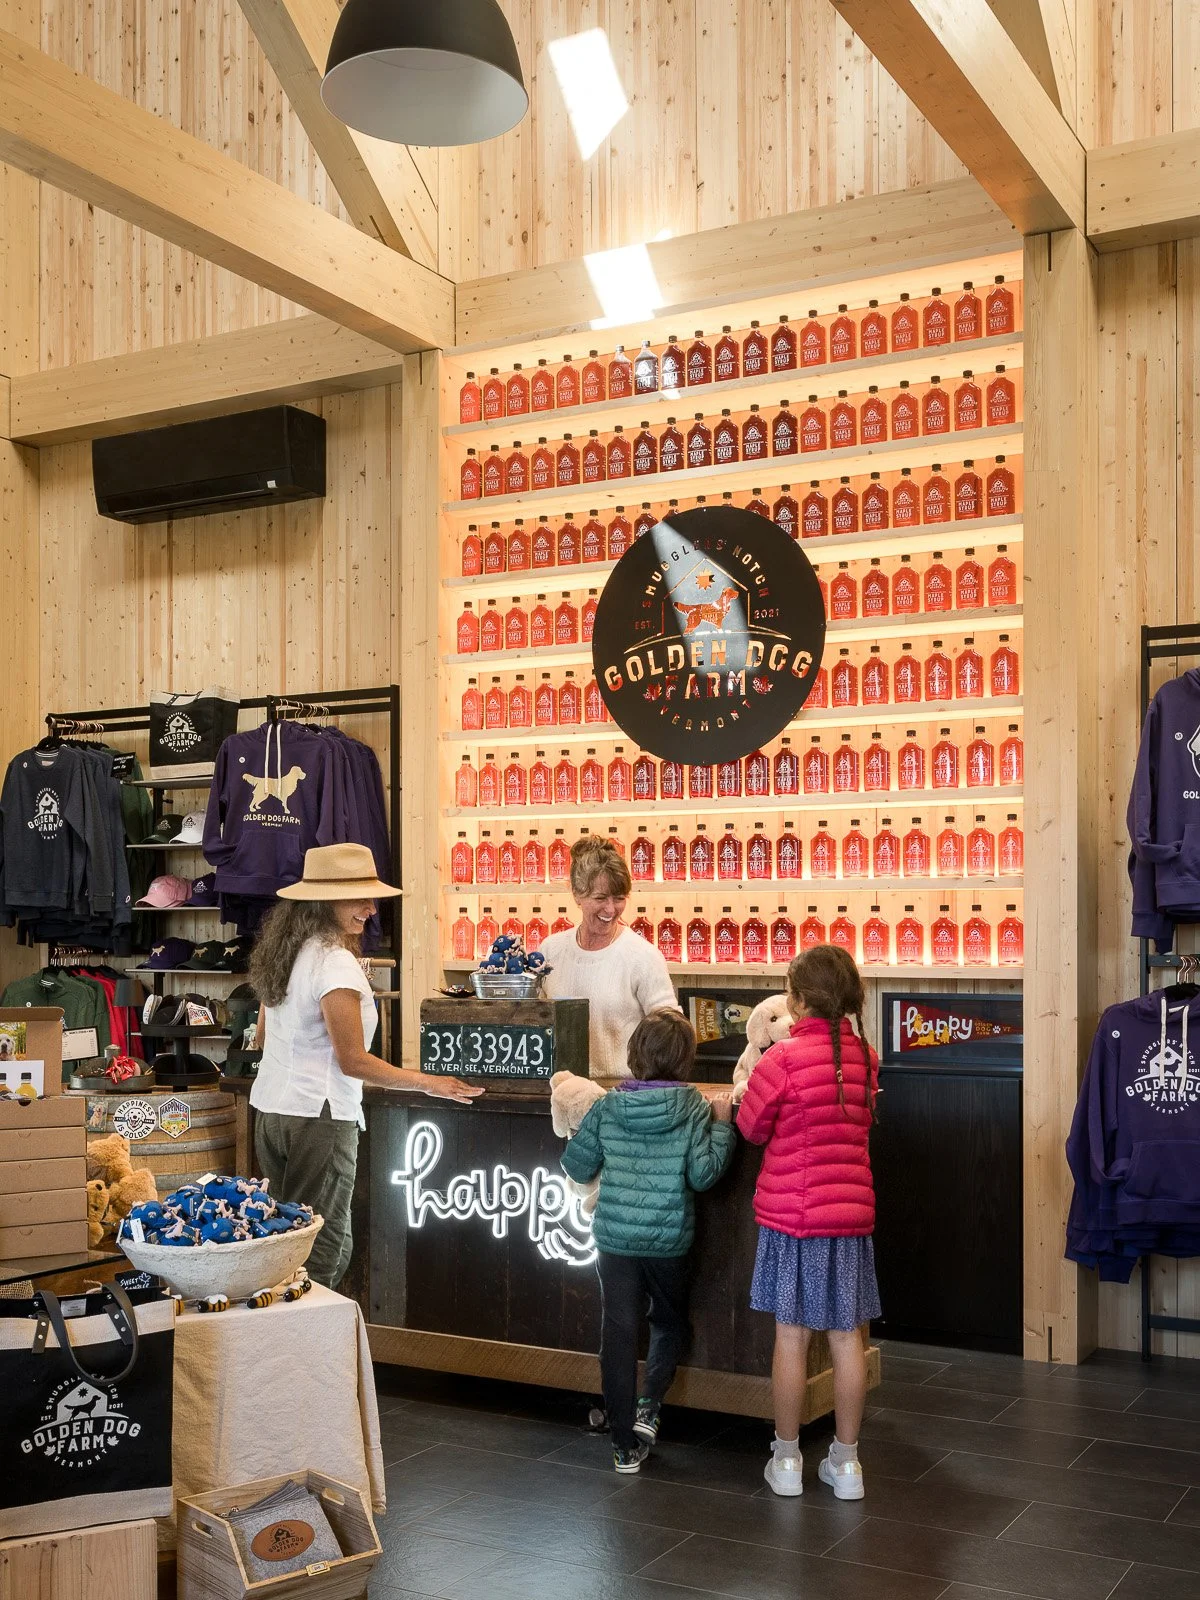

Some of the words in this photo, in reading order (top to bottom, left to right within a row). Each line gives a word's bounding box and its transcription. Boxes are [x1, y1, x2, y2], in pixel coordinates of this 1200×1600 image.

[732, 545, 770, 598] NOTCH
[635, 621, 655, 630] EST.
[604, 640, 726, 692] GOLDEN
[745, 640, 813, 678] DOG
[666, 669, 746, 700] FARM
[660, 700, 751, 731] VERMONT
[160, 733, 185, 744] GOLDEN
[706, 1009, 714, 1032] FARM
[902, 1006, 973, 1040] happy
[469, 1033, 544, 1066] 33943
[1141, 1039, 1178, 1064] SMUGGLRS'
[424, 1063, 436, 1071] SEE
[482, 1064, 530, 1074] VERMONT
[1125, 1079, 1178, 1096] GOLDEN
[1152, 1091, 1186, 1101] FARM
[118, 1100, 155, 1116] HAPPINESS
[1151, 1102, 1189, 1114] VERMONT
[124, 1125, 151, 1138] GOLDEN
[120, 1278, 138, 1286] SWEET
[20, 1420, 94, 1453] GOLDEN
[103, 1419, 141, 1437] DOG
[58, 1434, 104, 1454] FARM
[54, 1448, 107, 1468] VERMONT
